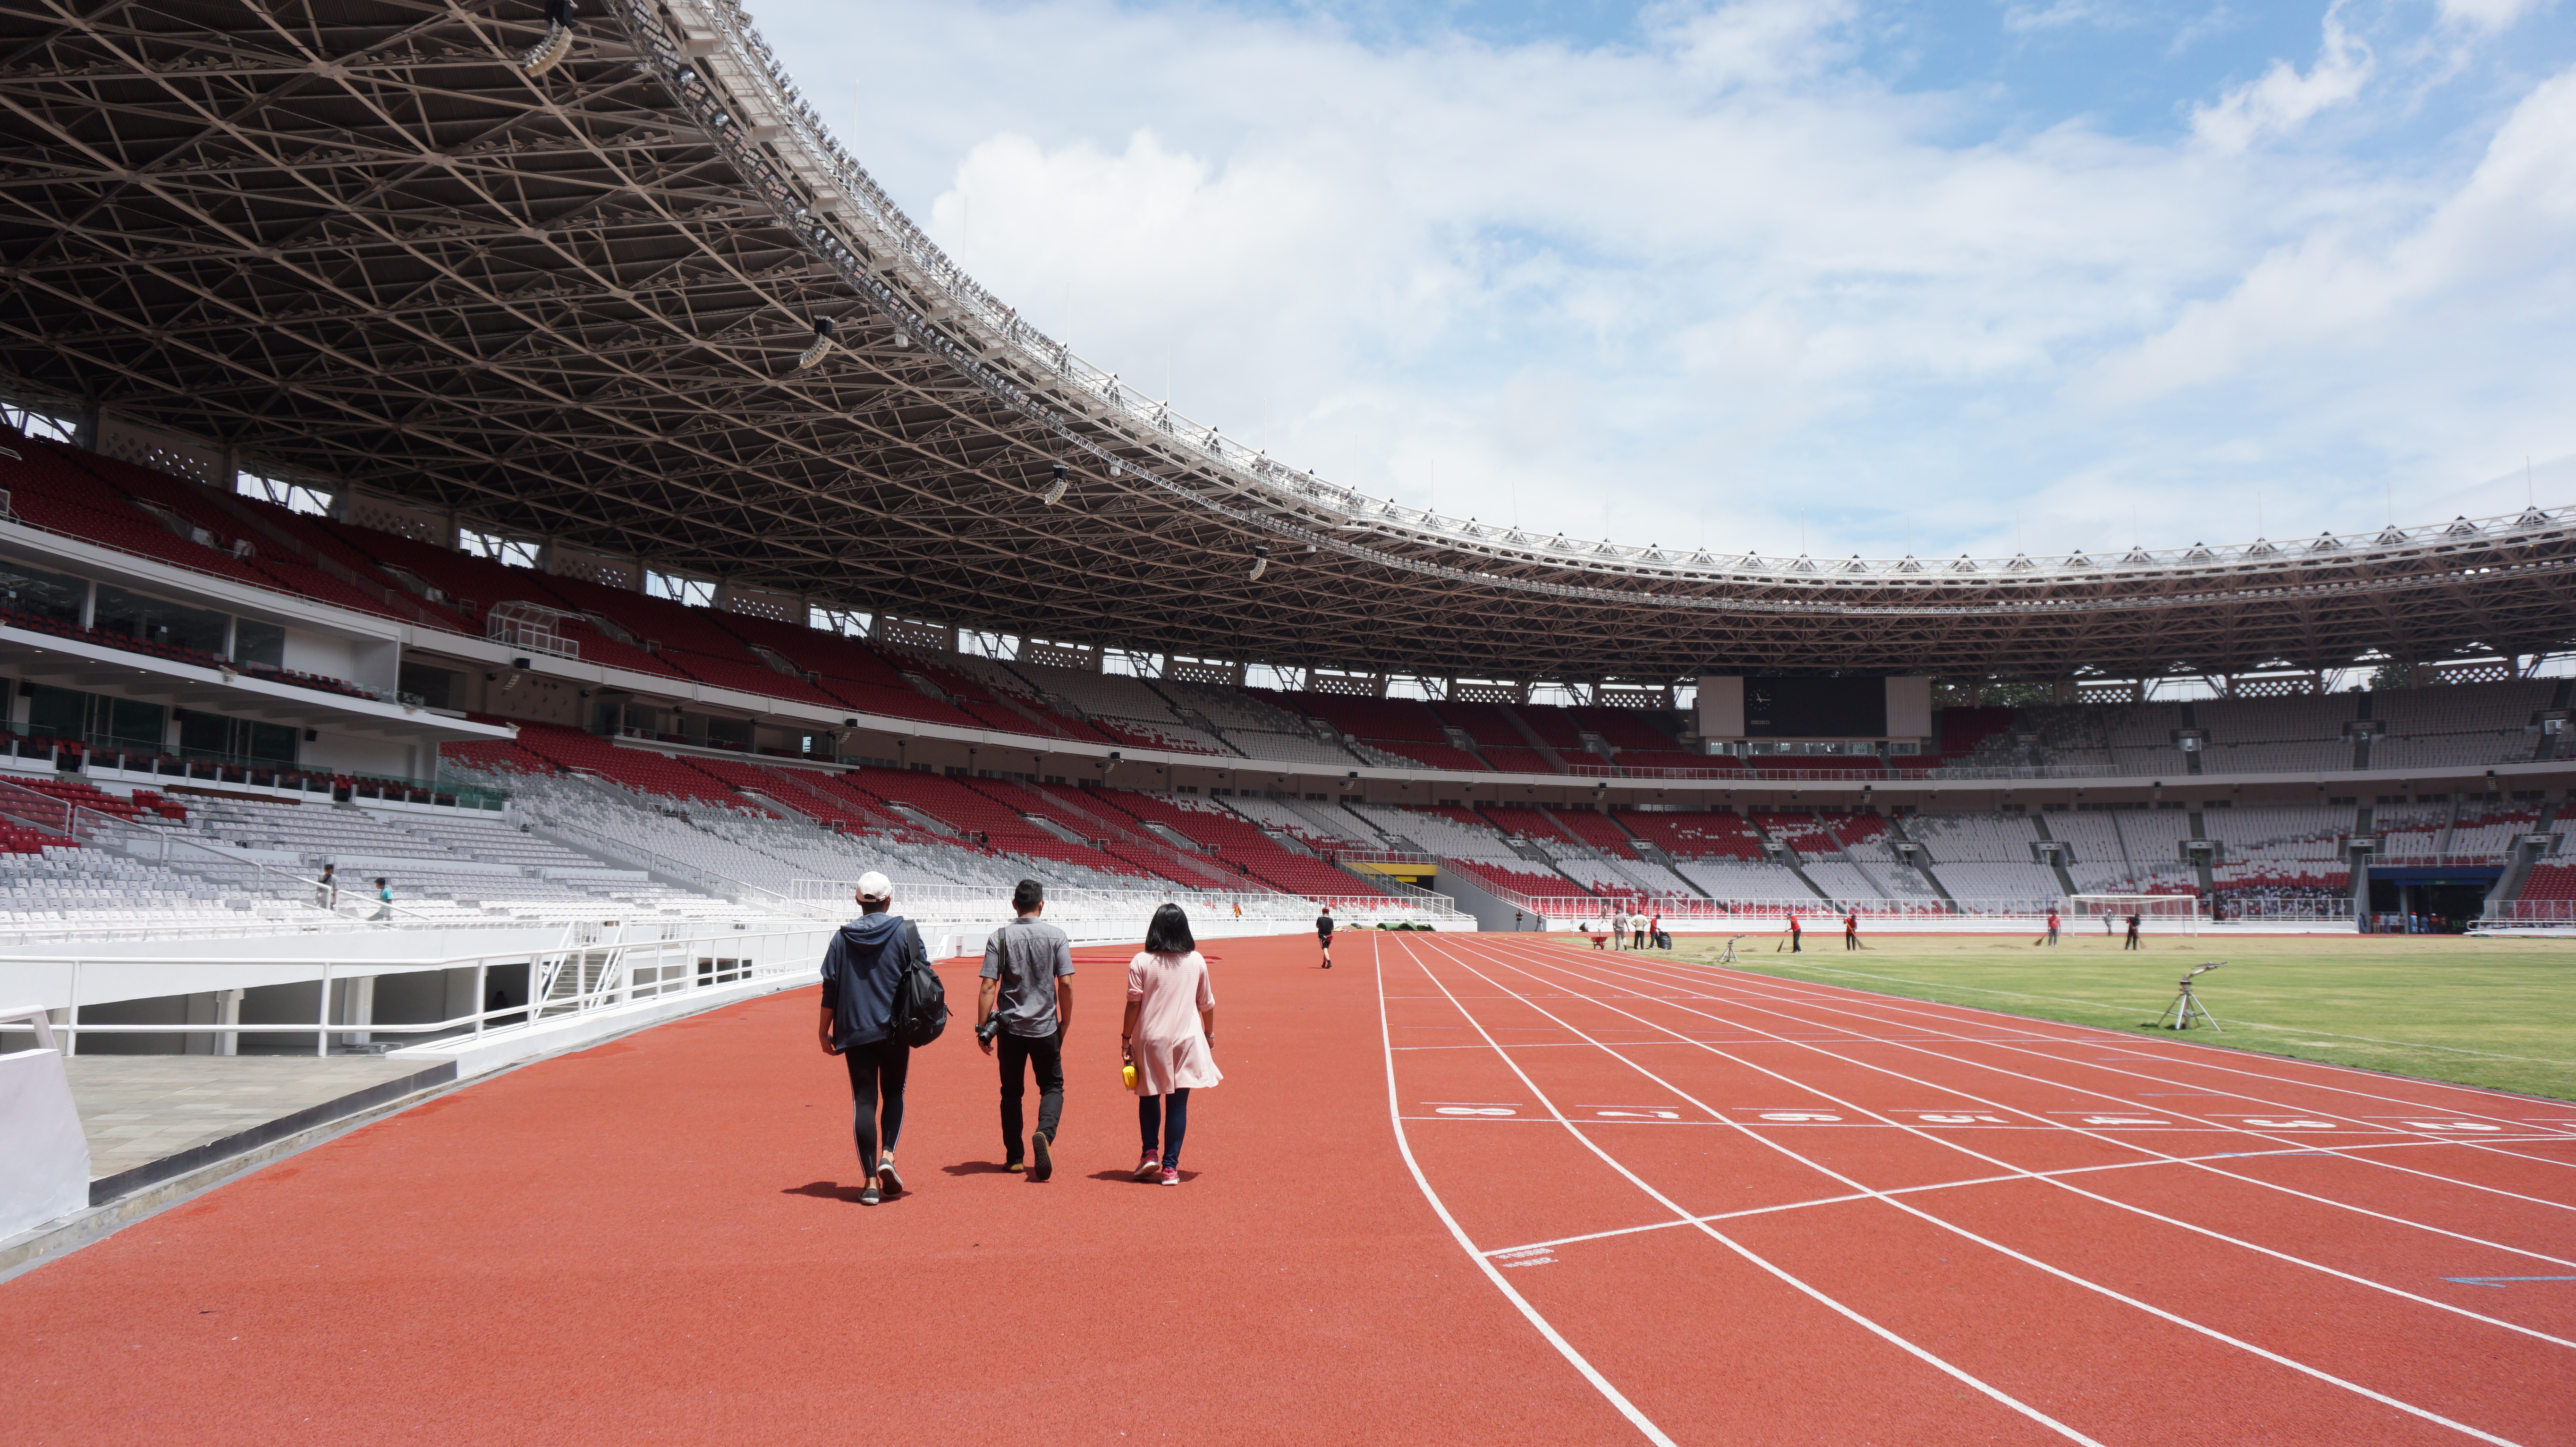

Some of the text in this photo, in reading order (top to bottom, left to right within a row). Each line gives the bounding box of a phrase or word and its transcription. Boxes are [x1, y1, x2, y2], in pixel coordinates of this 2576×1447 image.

[1435, 1107, 1517, 1115] 8
[1596, 1111, 1681, 1119] 7
[1758, 1112, 1843, 1121] 6
[1918, 1114, 2010, 1123] 5
[2082, 1115, 2172, 1124] 4
[2242, 1119, 2337, 1128] 3
[2399, 1121, 2501, 1131] 2
